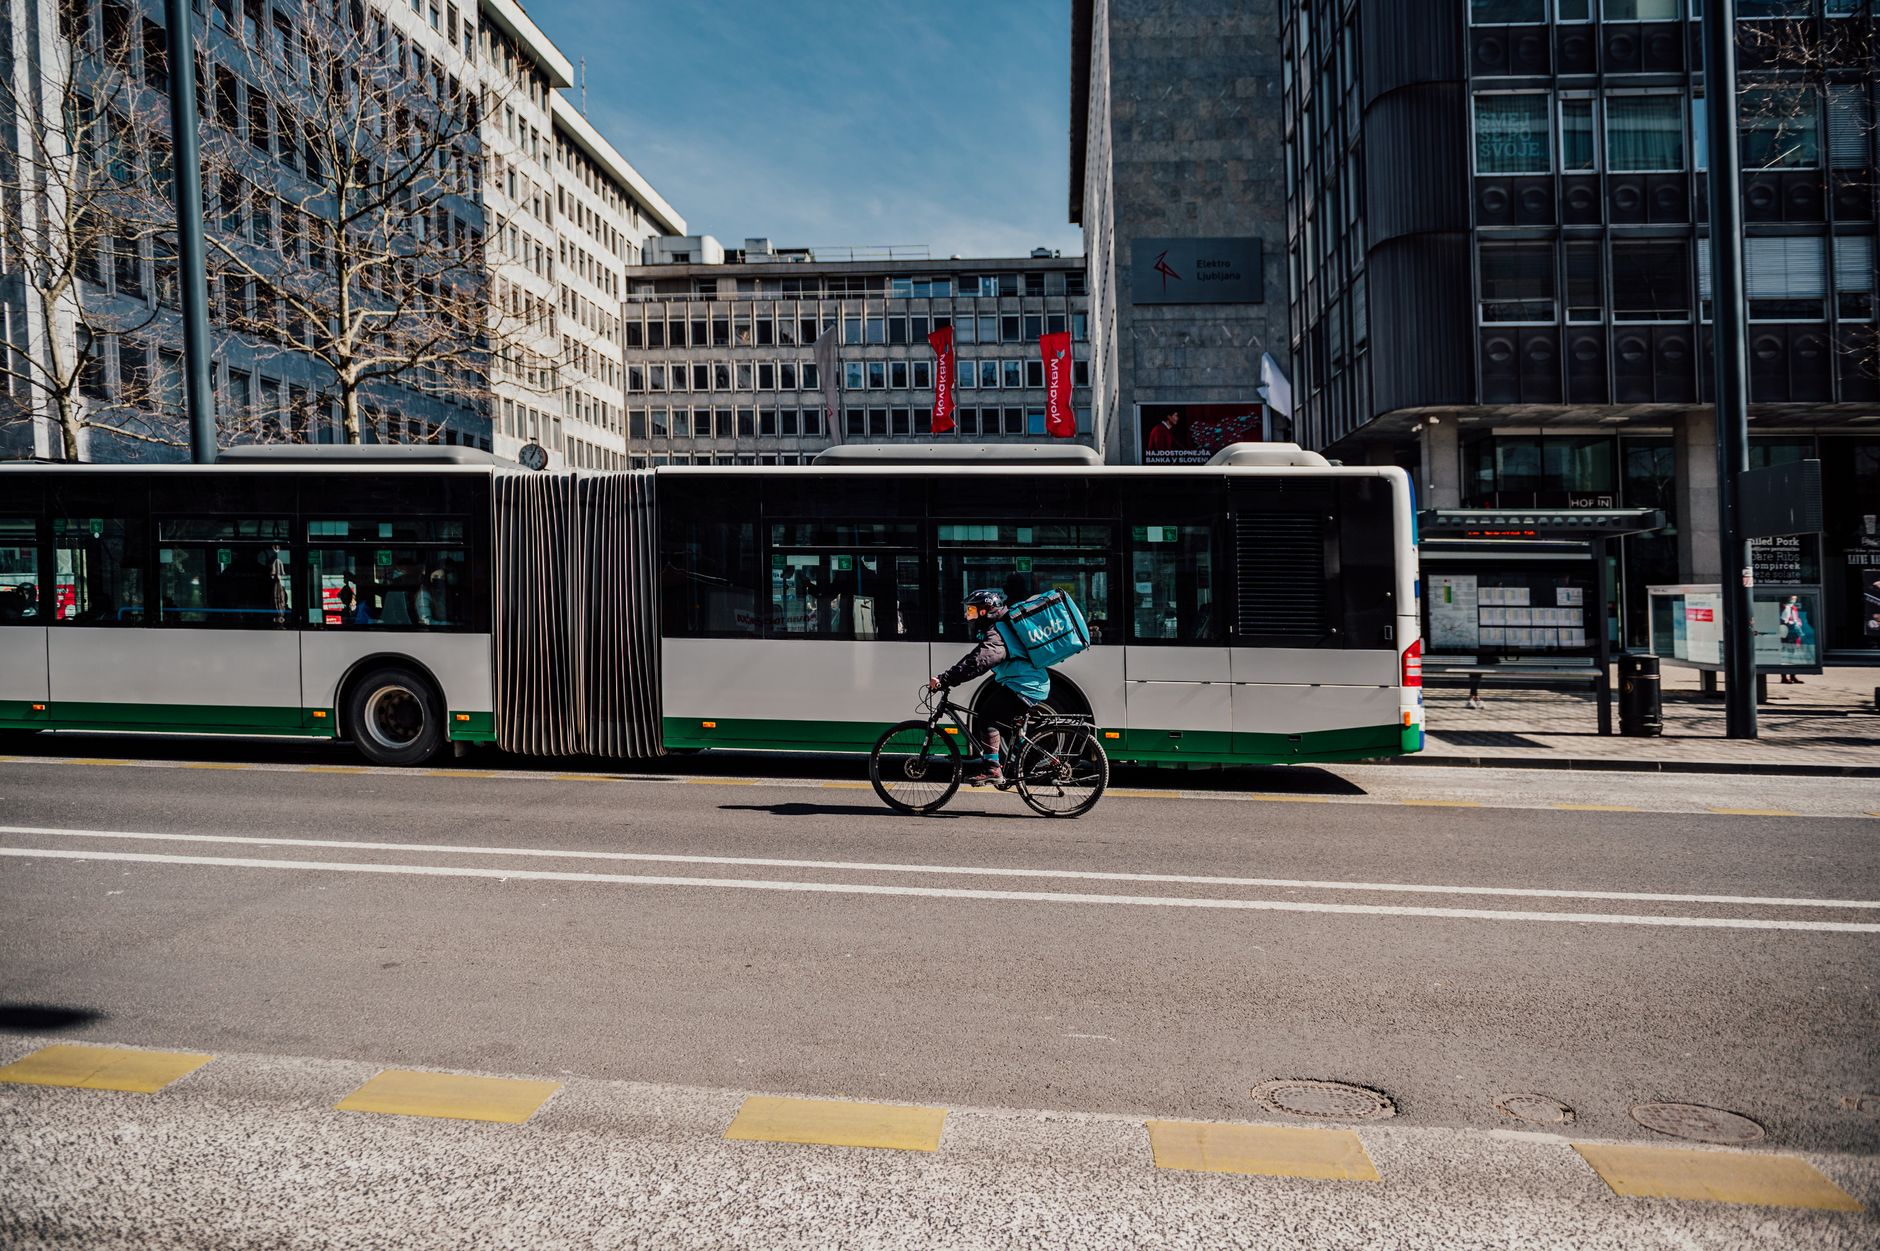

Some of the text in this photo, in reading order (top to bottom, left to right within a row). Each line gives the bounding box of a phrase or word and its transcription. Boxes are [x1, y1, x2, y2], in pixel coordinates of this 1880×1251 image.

[1479, 112, 1530, 126] SMEJ
[1479, 127, 1531, 141] SE PO
[1196, 259, 1231, 269] Elektro
[1196, 271, 1241, 282] Ljubljana
[1776, 537, 1800, 546] Pork
[1776, 552, 1800, 562] Ribs
[1752, 562, 1801, 571] ompirček
[1028, 619, 1064, 643] Wolt
